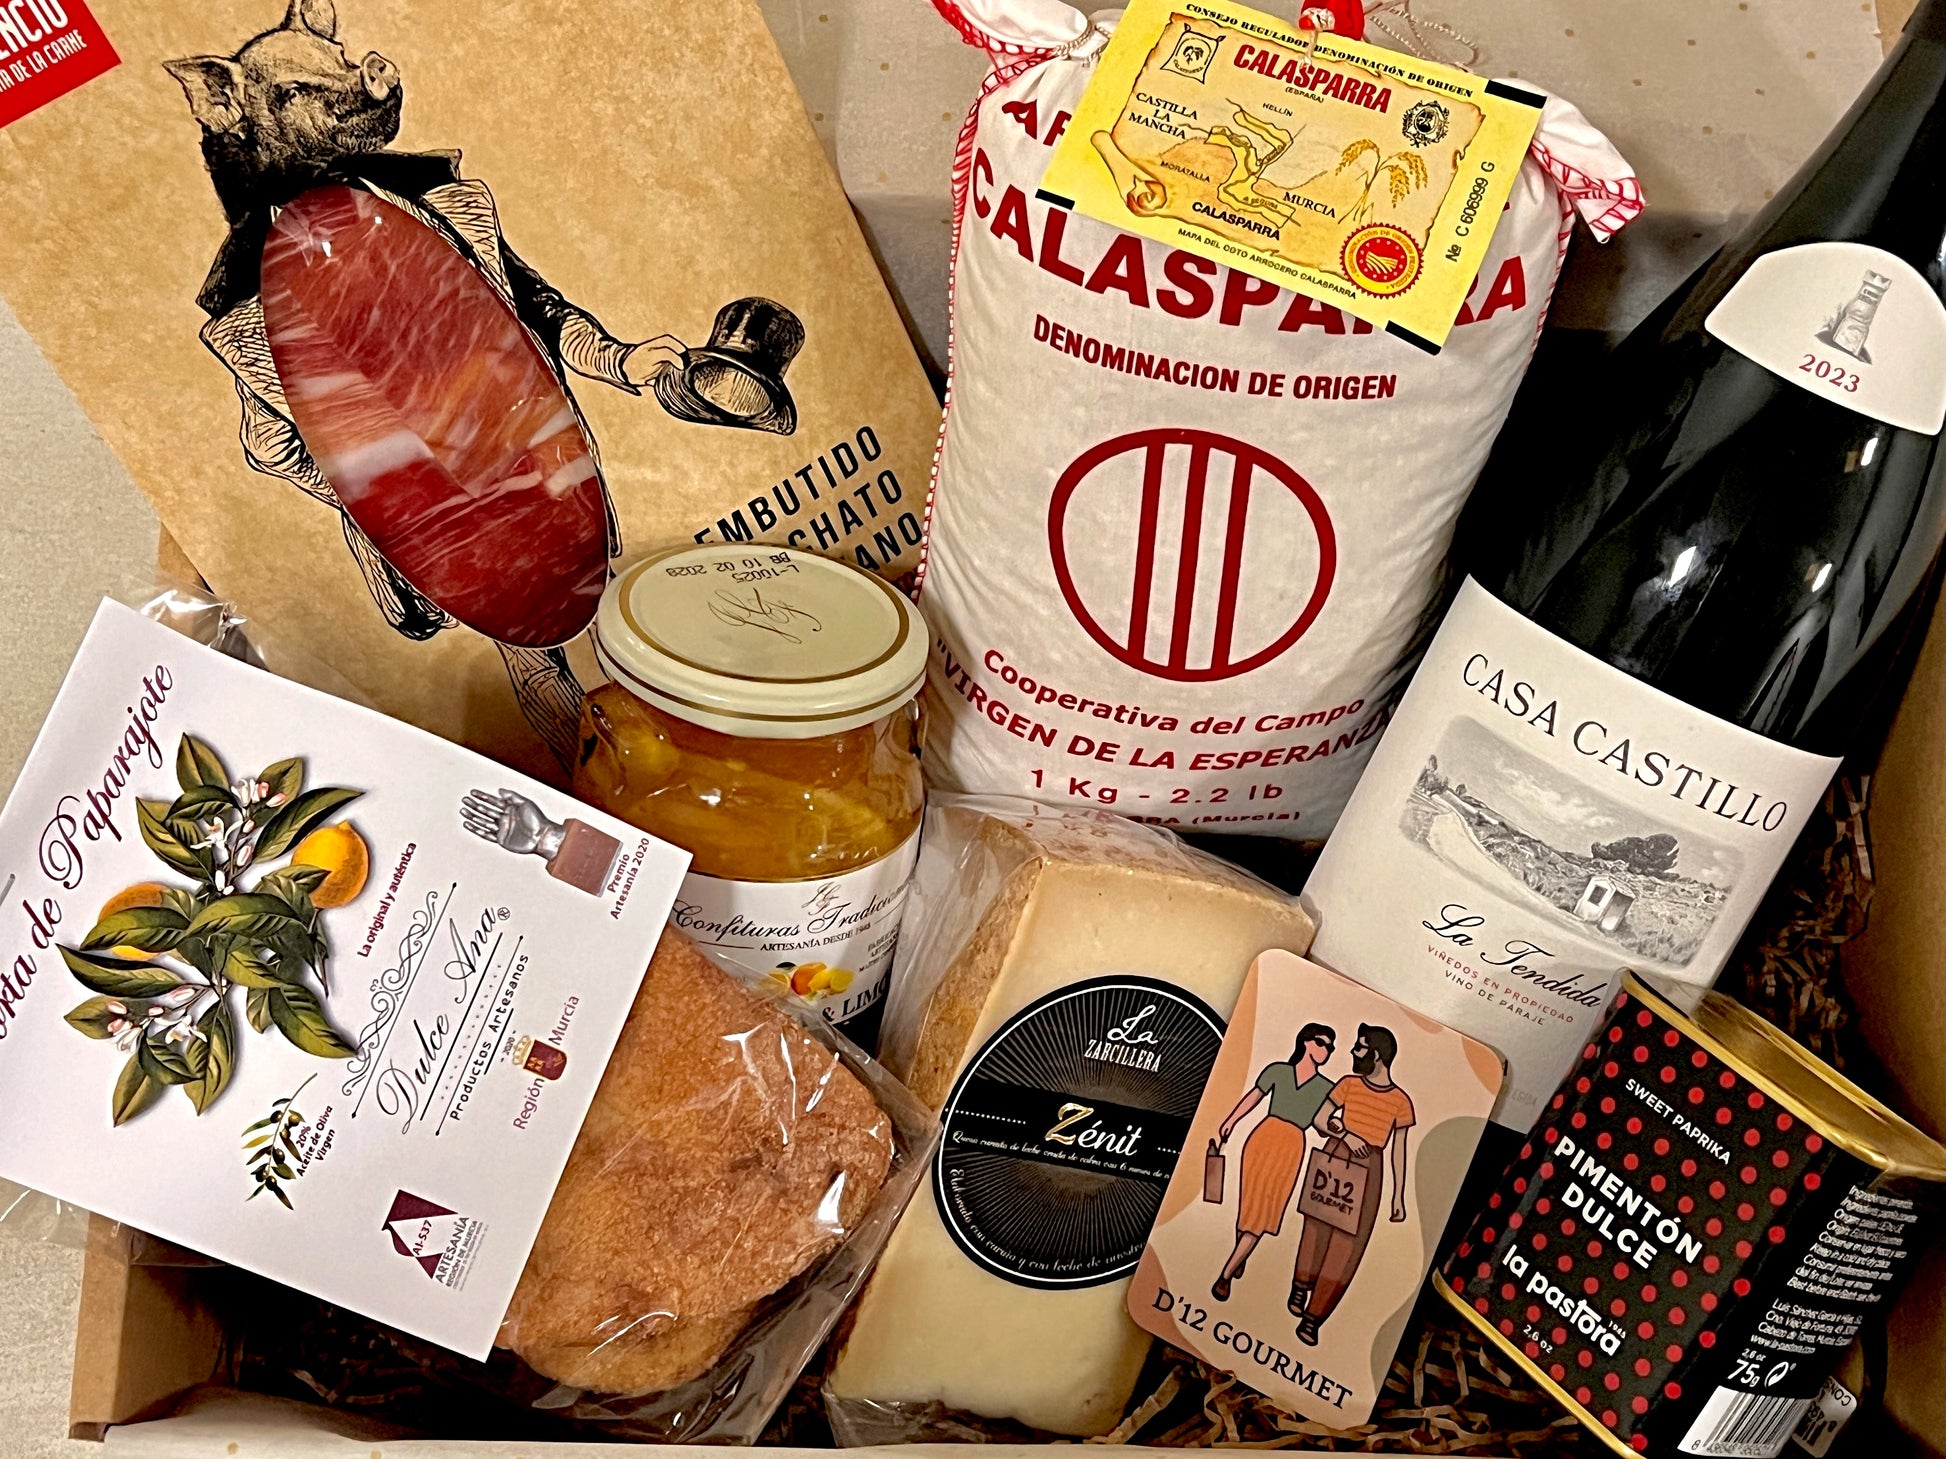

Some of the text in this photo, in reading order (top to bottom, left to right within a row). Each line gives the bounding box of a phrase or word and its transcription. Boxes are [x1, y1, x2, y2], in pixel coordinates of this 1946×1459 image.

[9, 60, 32, 82] DE
[26, 54, 48, 73] LA
[43, 29, 87, 63] CARNE
[1186, 3, 1238, 26] CONSEJO
[1315, 44, 1404, 77] DENOMINACIÓN
[1408, 71, 1424, 83] DE
[1427, 78, 1473, 98] ORIGEN
[1234, 44, 1392, 113] CALASPARRA
[1129, 112, 1186, 139] MANCHA
[1136, 92, 1198, 120] CASTILLA
[1153, 109, 1171, 122] LA
[1160, 161, 1211, 182] MORATALLA
[1481, 161, 1495, 173] G
[1192, 202, 1280, 241] CALASPARRA
[1283, 191, 1336, 219] MURCIA
[1460, 177, 1489, 225] 606999
[1456, 225, 1470, 237] C
[1178, 228, 1357, 299] MAPA DEL COTO ARROCERO CALASPARRA
[1033, 314, 1397, 401] DENOMINACION DE ORIGEN
[1798, 353, 1861, 393] 2023
[713, 562, 735, 573] 02
[743, 558, 762, 569] 10
[984, 649, 1365, 735] Cooperativa del Campo
[1067, 735, 1121, 762] DE
[1129, 748, 1176, 770] LA
[1463, 653, 1788, 832] CASA CASTILLO
[1031, 770, 1043, 788] 1
[1069, 777, 1118, 805] Kg
[1171, 786, 1229, 804] 2.2
[1250, 783, 1284, 801] lb
[0, 665, 173, 1039] rta de Paparajote
[607, 853, 631, 893] Premio
[357, 842, 417, 958] La original y auténtica
[610, 838, 650, 920] Artesanía 2020
[672, 900, 800, 941] Confituras
[760, 934, 821, 952] ARTESANÍA
[823, 931, 853, 946] DESDE
[1422, 904, 1608, 1008] La Tendida
[1427, 945, 1575, 1024] VIÑEDOS EN PROPIEDAD
[1445, 969, 1546, 1026] VINO DE PARAJE
[450, 954, 529, 1121] Productos Artesanos
[1107, 1004, 1159, 1045] La
[376, 1014, 450, 1135] Dulce
[513, 995, 580, 1130] Región Murcia
[1084, 1039, 1162, 1073] ZARCILLERA
[295, 1125, 312, 1148] 20%
[296, 1105, 333, 1177] Aceite de Oliva
[315, 1129, 336, 1162] Virgen
[1045, 1102, 1142, 1157] Zénit
[1625, 1078, 1731, 1166] SWEET PAPRIKA
[1311, 1168, 1356, 1204] D'12
[1554, 1135, 1703, 1264] PIMENTÓN
[435, 1217, 470, 1284] ARTESANÍA
[1561, 1182, 1658, 1269] DULCE
[1018, 1257, 1026, 1271] y
[1052, 1259, 1083, 1272] leche
[1502, 1244, 1622, 1357] la pastora
[1152, 1287, 1353, 1410] D'12 GOURMET
[1540, 1340, 1554, 1354] oz
